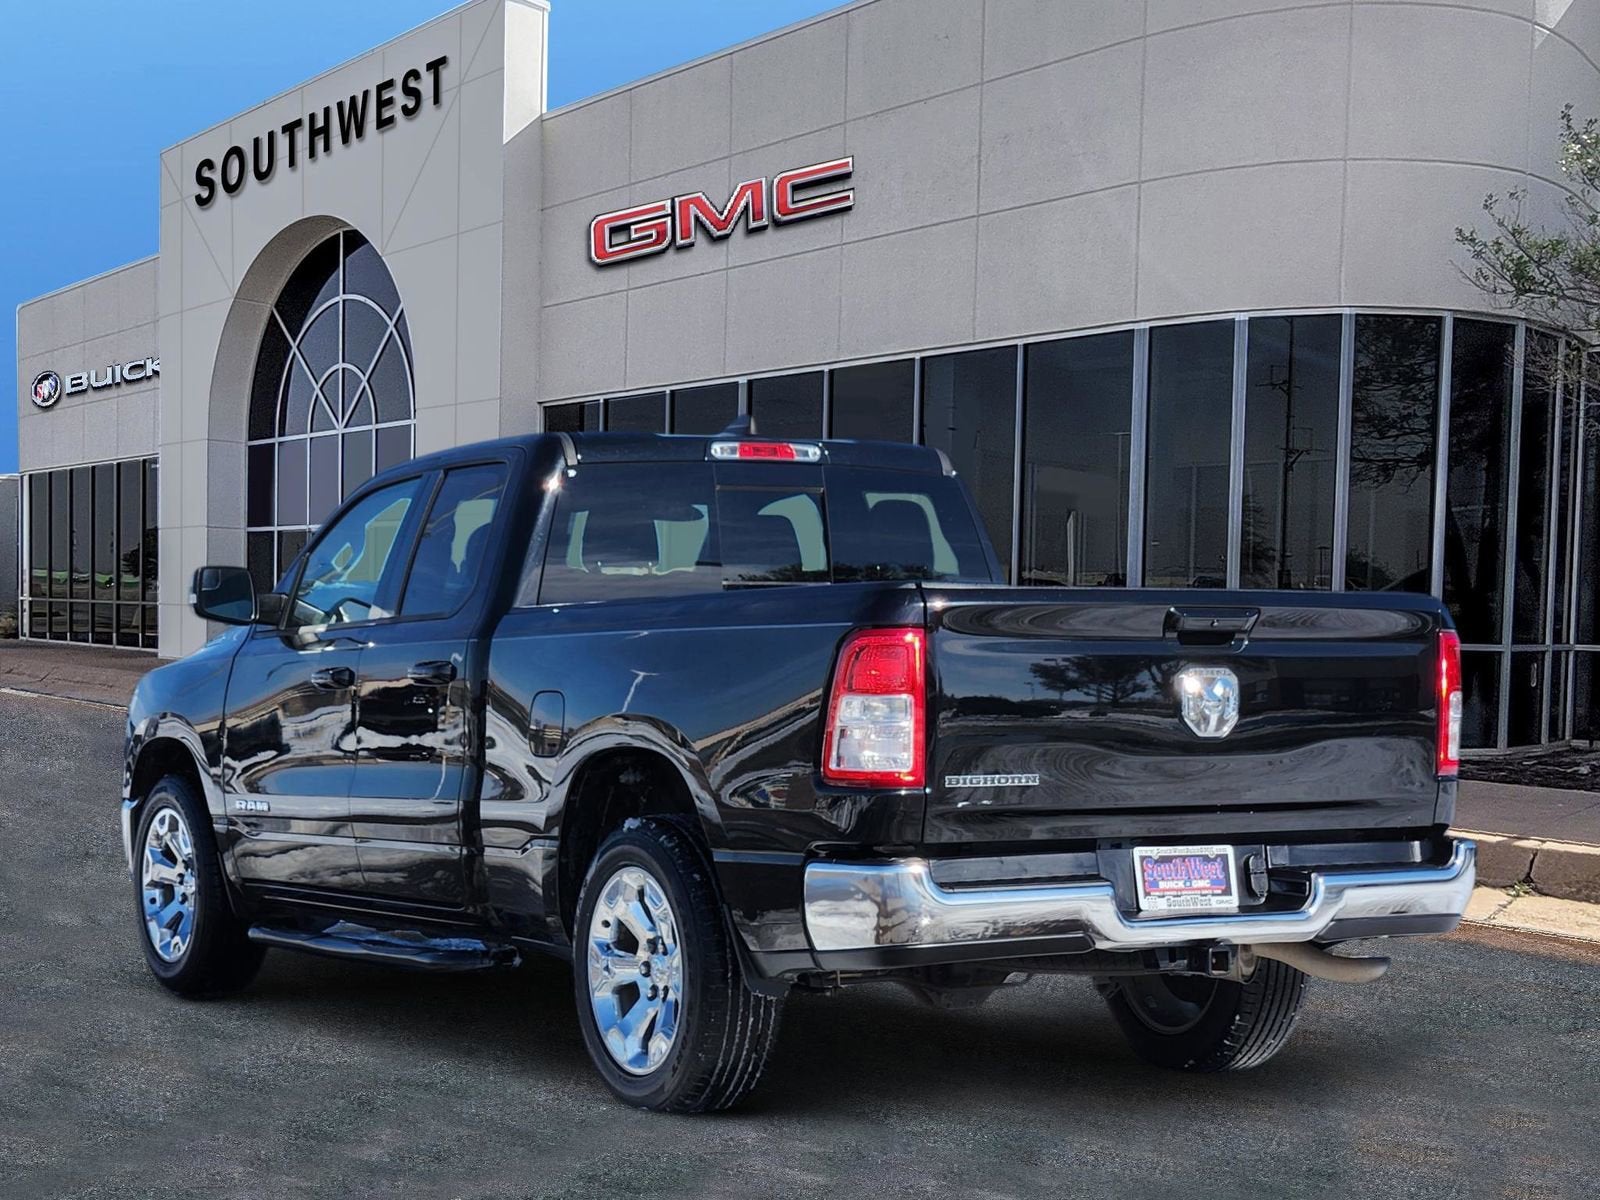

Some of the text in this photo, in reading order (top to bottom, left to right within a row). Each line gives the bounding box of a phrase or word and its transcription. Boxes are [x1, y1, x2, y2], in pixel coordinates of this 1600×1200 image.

[194, 55, 448, 207] SOUTHWEST
[589, 155, 855, 266] GMC
[64, 357, 160, 395] BUICK
[945, 774, 1039, 787] BIGHORN
[235, 800, 270, 812] RAM
[1191, 878, 1212, 888] GMC
[1166, 896, 1212, 908] SouthWest
